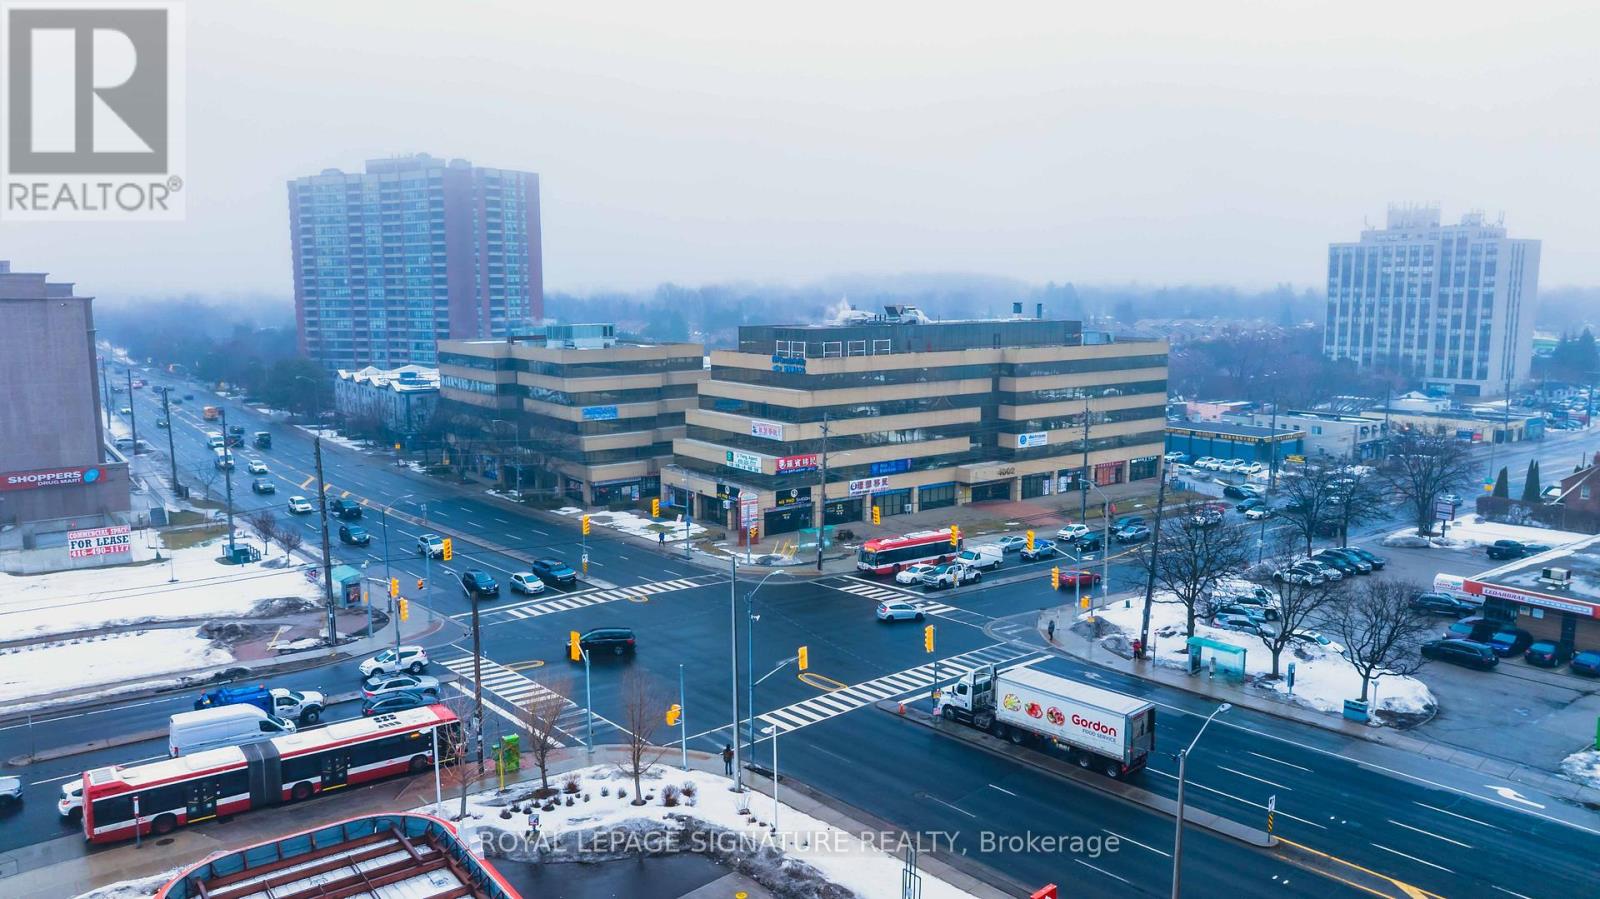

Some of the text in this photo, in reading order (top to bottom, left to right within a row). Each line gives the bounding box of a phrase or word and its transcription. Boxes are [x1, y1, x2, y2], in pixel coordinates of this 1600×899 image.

[8, 471, 82, 484] SHOPPERS
[60, 478, 81, 486] MART
[69, 526, 129, 539] COMMERCIAL SPACE
[71, 535, 129, 549] FOR LEASE
[71, 545, 129, 557] 416-490-1177
[1071, 714, 1117, 736] Gordon
[1082, 728, 1116, 743] FOOD SERVICE
